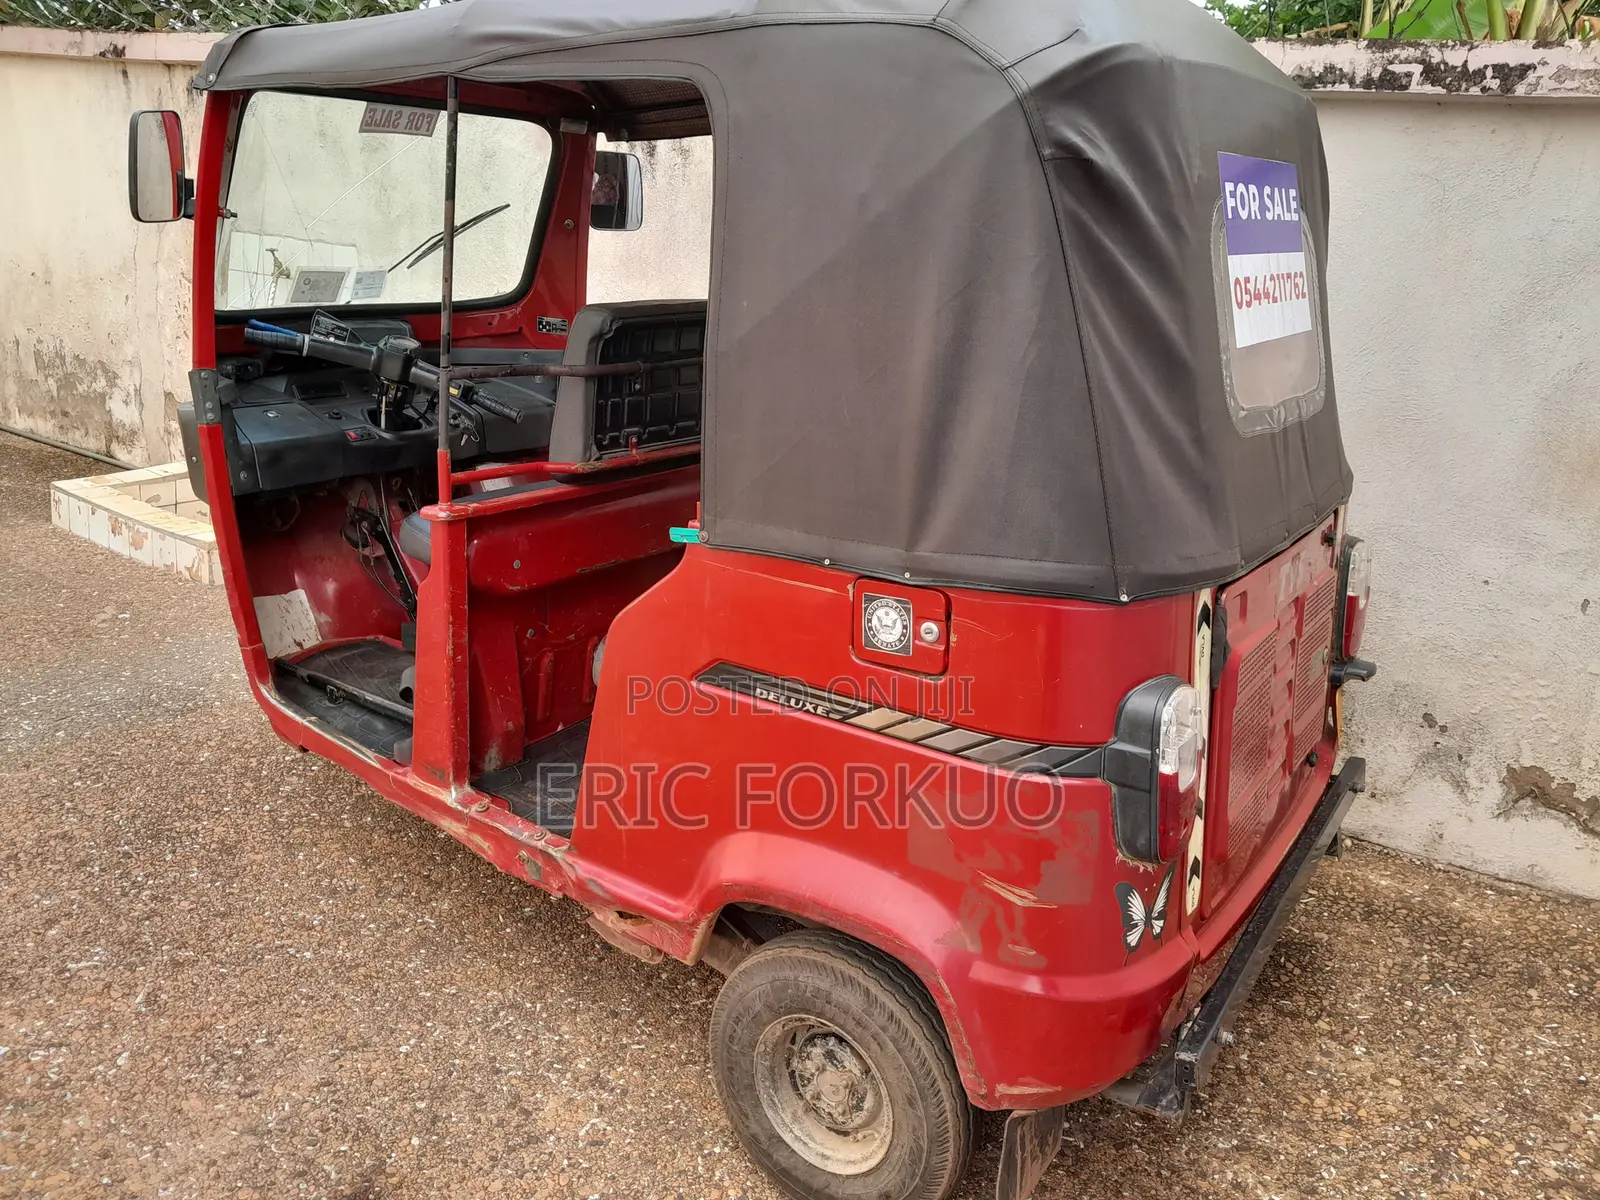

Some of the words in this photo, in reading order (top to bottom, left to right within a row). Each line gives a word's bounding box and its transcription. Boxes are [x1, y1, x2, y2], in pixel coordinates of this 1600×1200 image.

[1225, 181, 1261, 220] FOR
[1263, 185, 1299, 221] SALE
[1233, 271, 1307, 310] 0544211762
[754, 687, 830, 716] DELUXE
